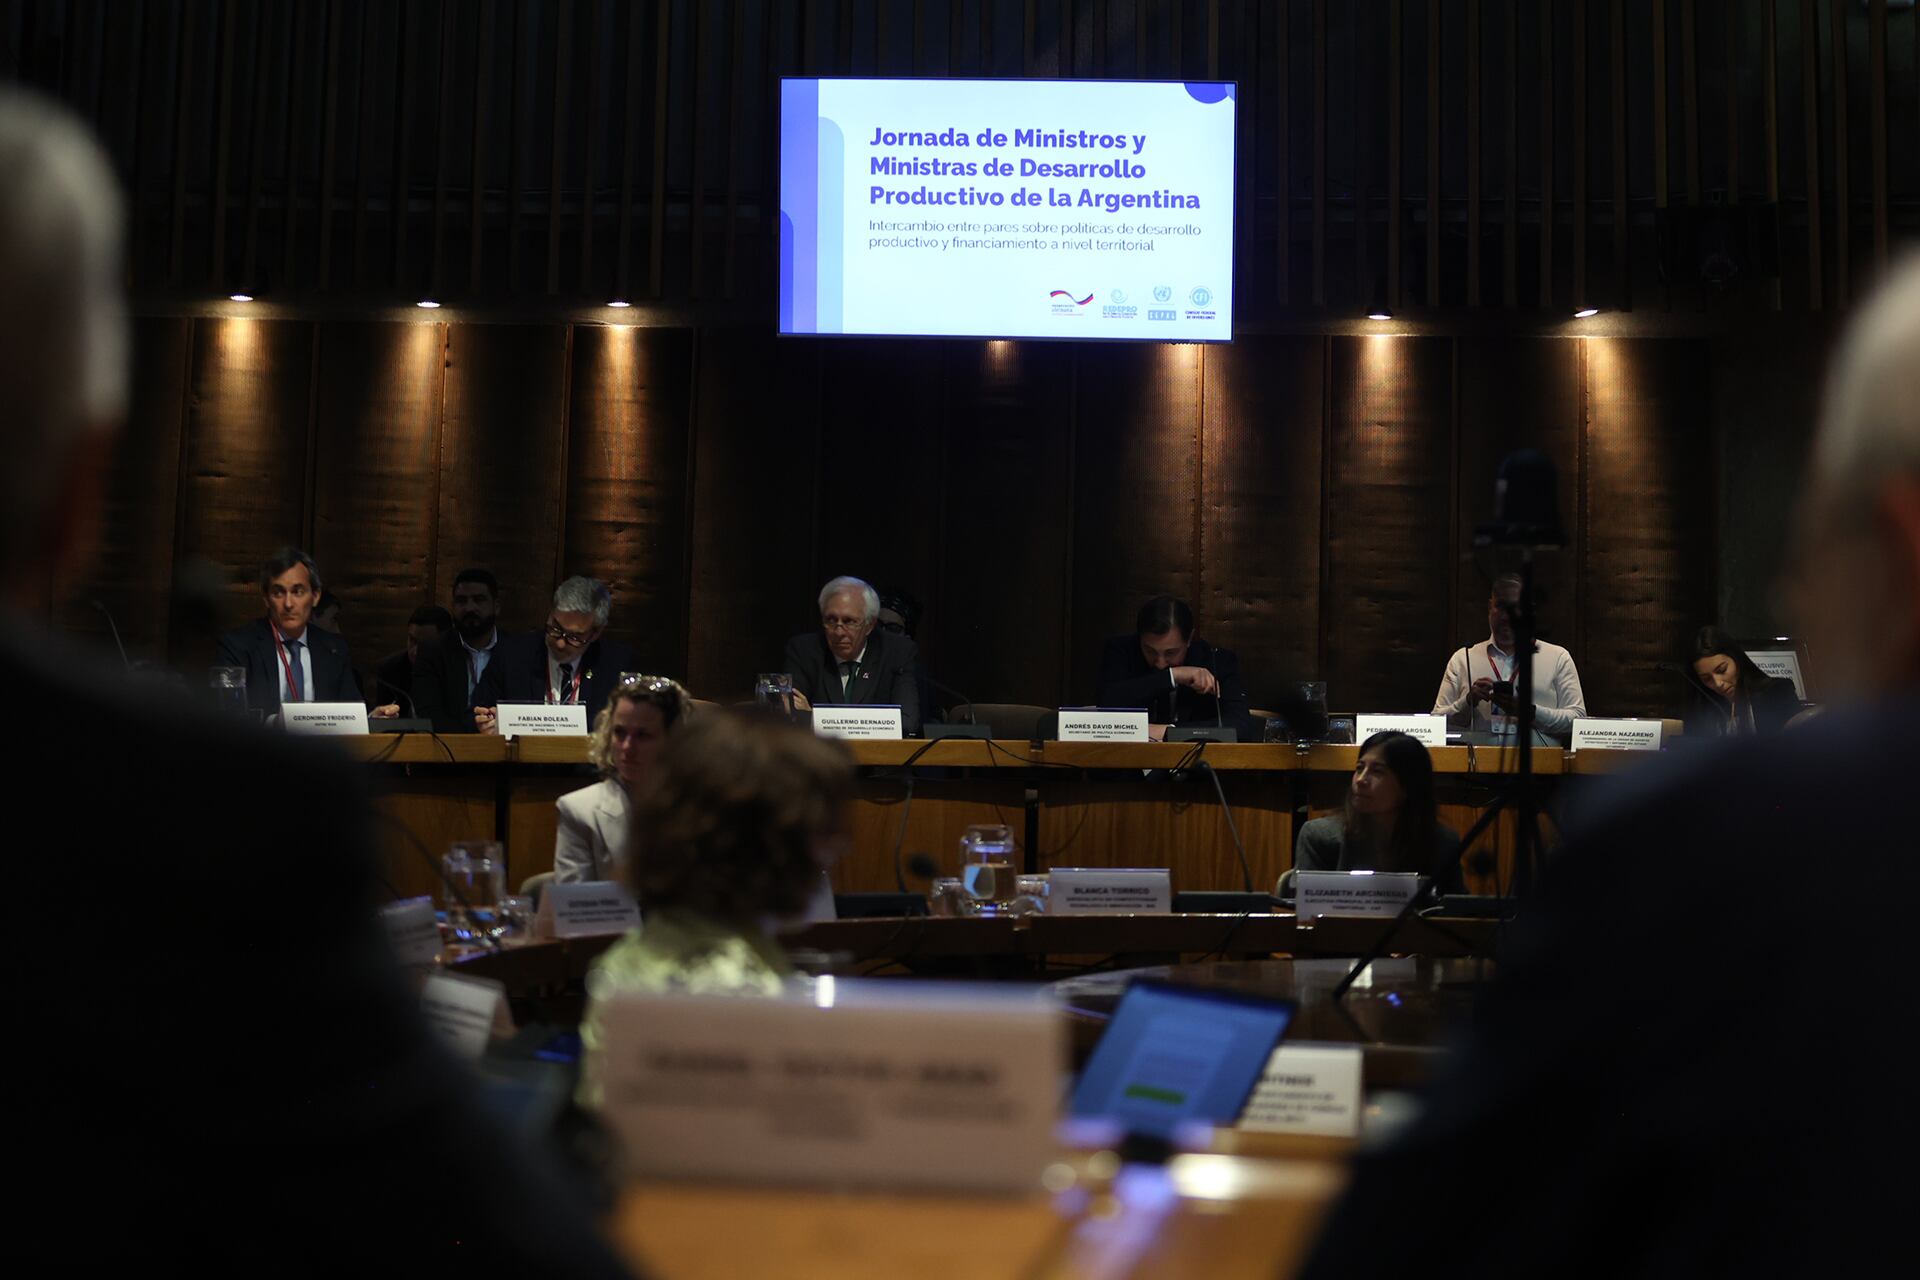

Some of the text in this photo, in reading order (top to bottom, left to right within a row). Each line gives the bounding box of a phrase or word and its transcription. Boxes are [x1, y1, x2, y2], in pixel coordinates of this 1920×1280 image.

[870, 128, 1146, 155] Jornada de Ministros y
[870, 156, 1146, 178] Ministras de Desarrollo
[870, 186, 1201, 213] Productivo de la Argentina
[869, 220, 944, 232] Intercambio
[947, 221, 981, 233] entre
[983, 224, 1019, 235] pares
[1022, 222, 1058, 233] sobre
[1117, 223, 1134, 235] de
[1137, 223, 1202, 236] desarrollo
[869, 236, 1155, 251] productivo y financiamiento a nivel territorial
